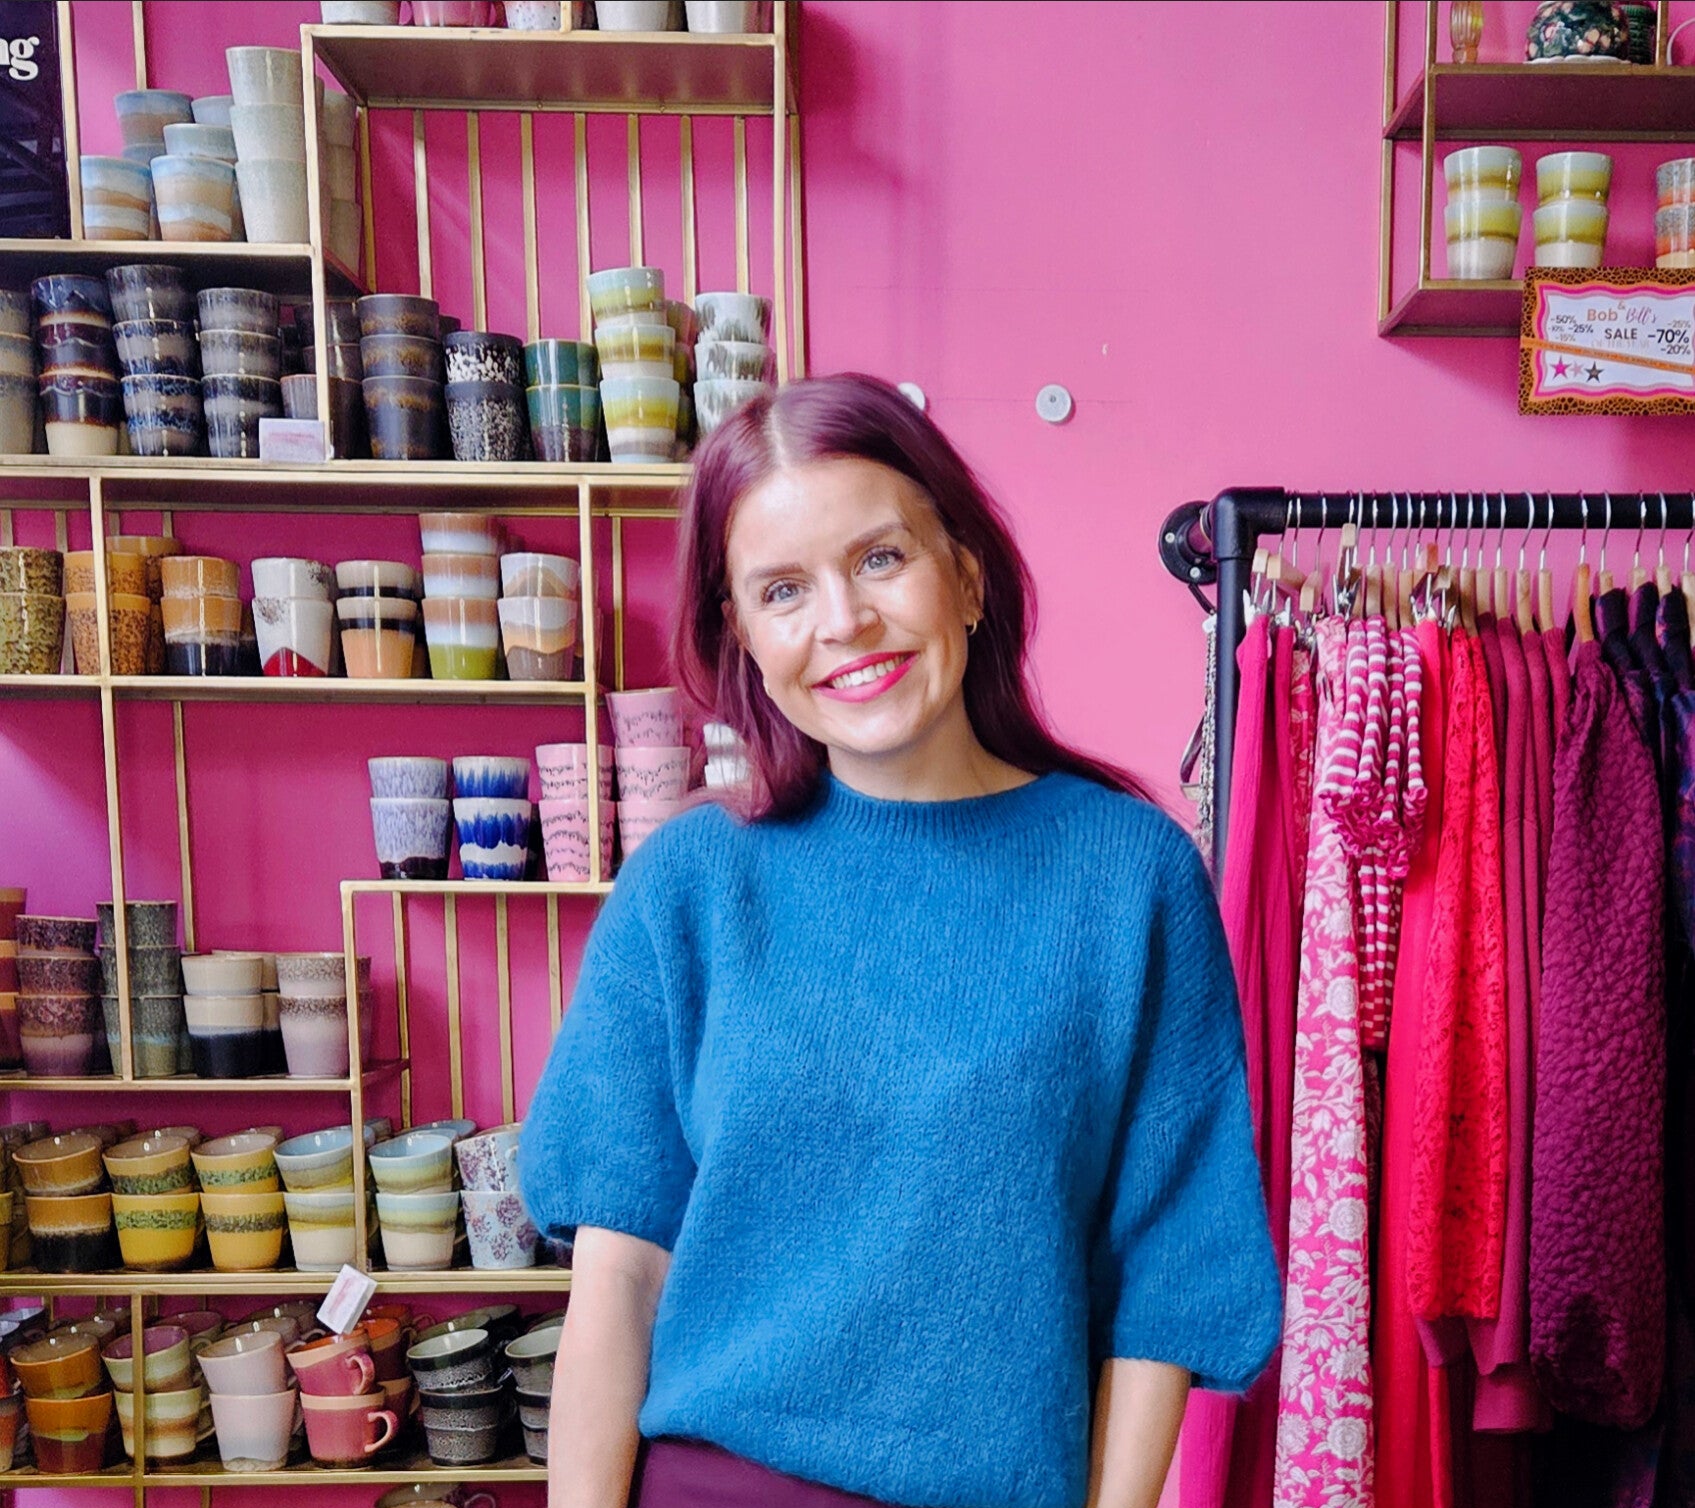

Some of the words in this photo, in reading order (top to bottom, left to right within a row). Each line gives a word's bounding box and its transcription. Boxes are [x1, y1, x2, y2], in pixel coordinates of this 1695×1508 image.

[1550, 314, 1576, 324] -50%
[1587, 308, 1618, 322] Bob
[1626, 306, 1657, 325] Bill's
[1568, 324, 1594, 333] -25%
[1604, 327, 1638, 340] SALE
[1647, 328, 1690, 344] -70%
[1660, 344, 1691, 355] -20%
